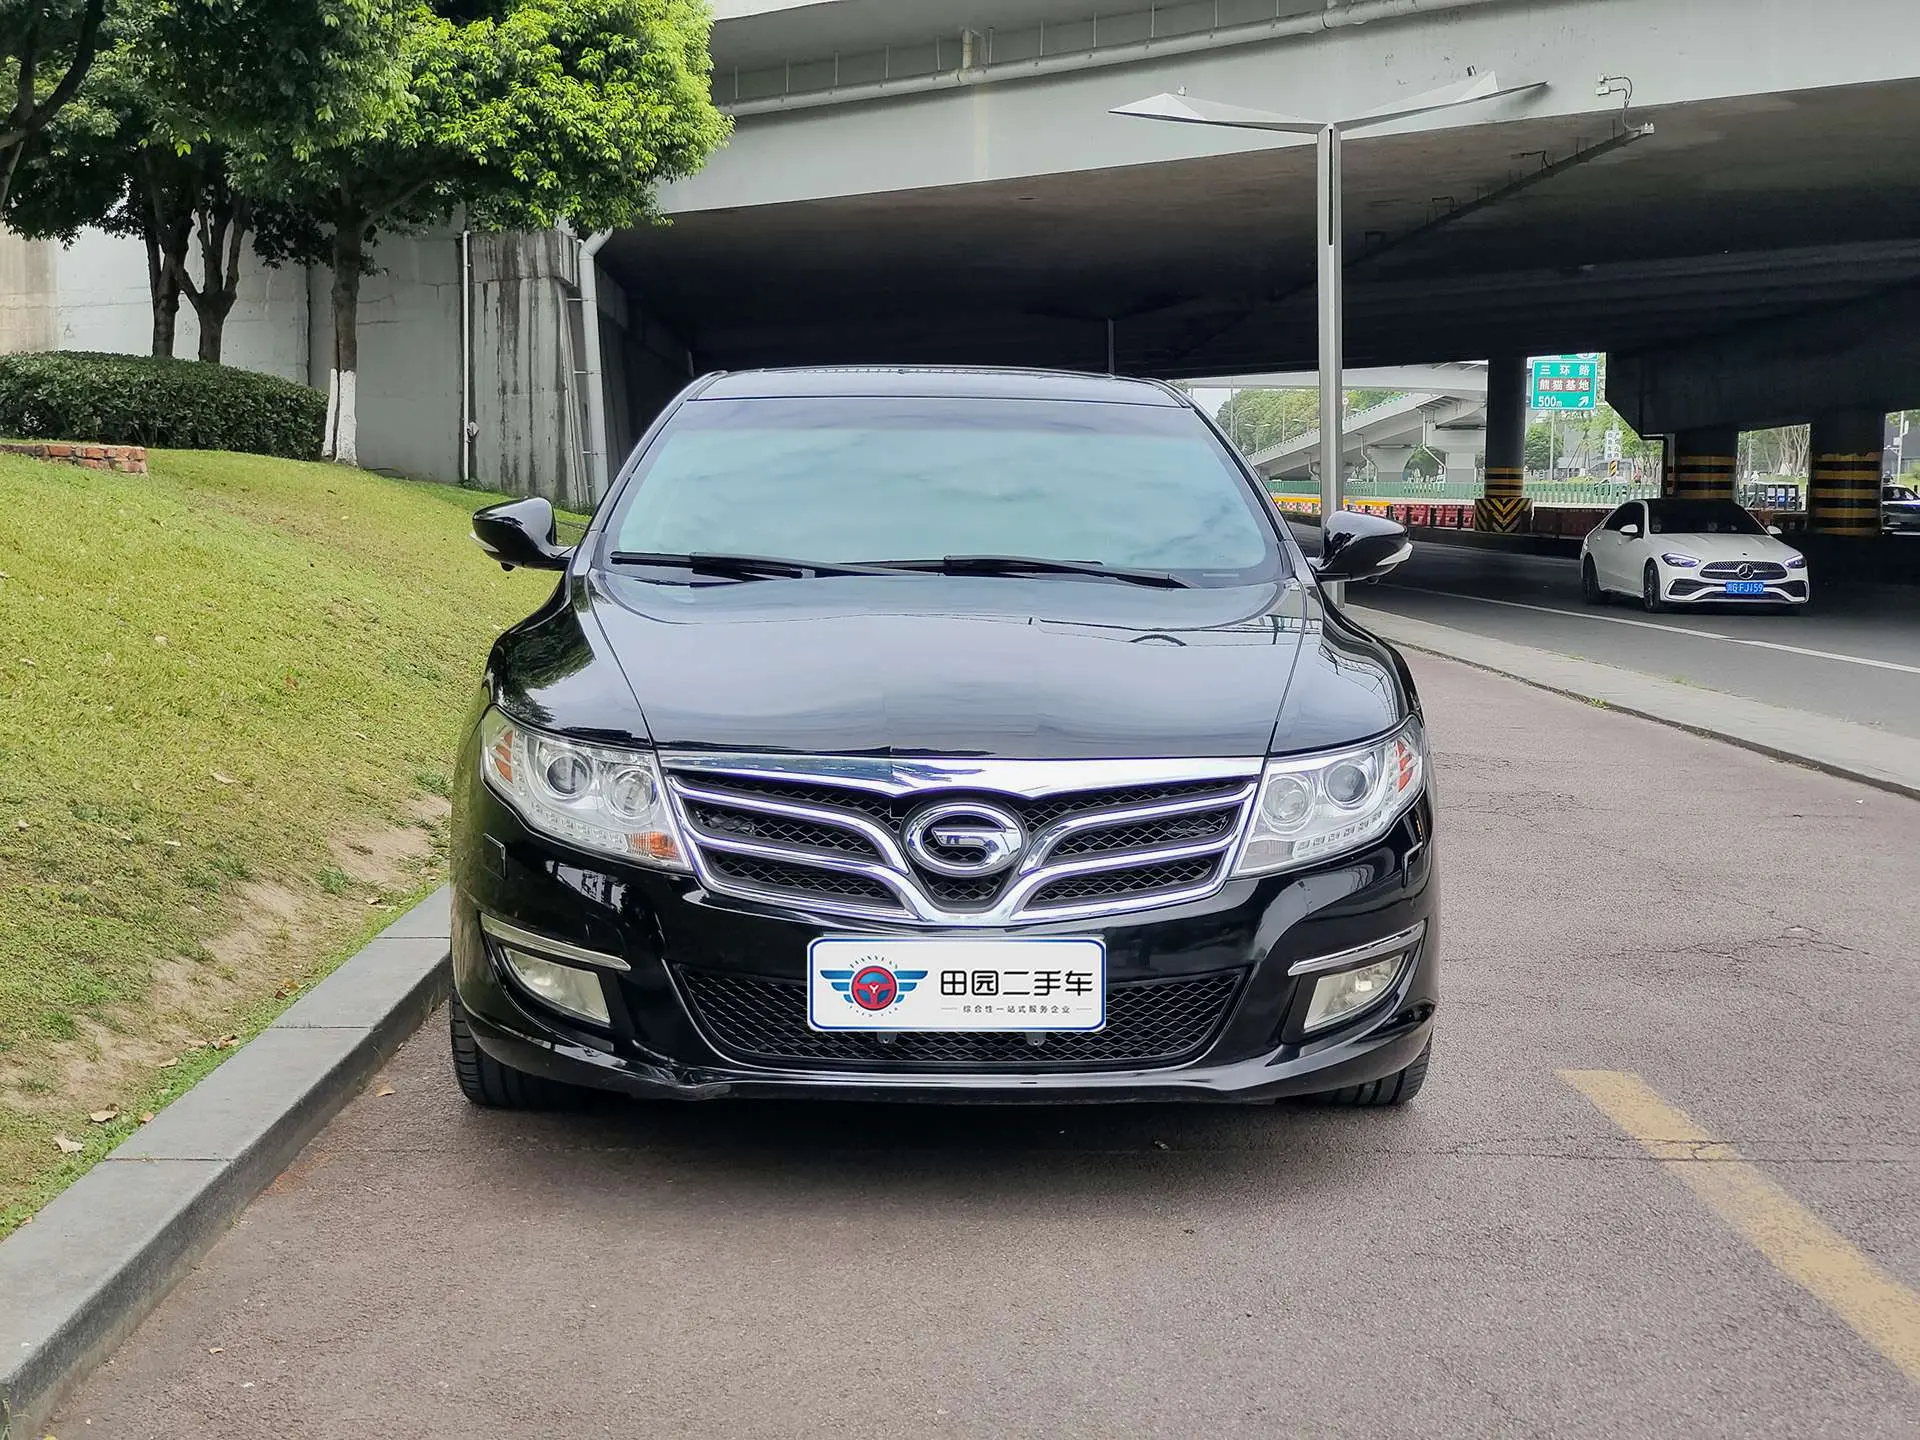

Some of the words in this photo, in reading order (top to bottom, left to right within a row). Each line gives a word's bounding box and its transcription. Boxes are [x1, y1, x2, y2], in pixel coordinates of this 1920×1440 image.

[1540, 364, 1590, 376] 三环路
[1539, 379, 1590, 391] 熊猫基地
[1538, 395, 1563, 407] 500m
[940, 969, 1093, 996] 田园二手车
[963, 1004, 1071, 1014] 综合性一站式服务企业
